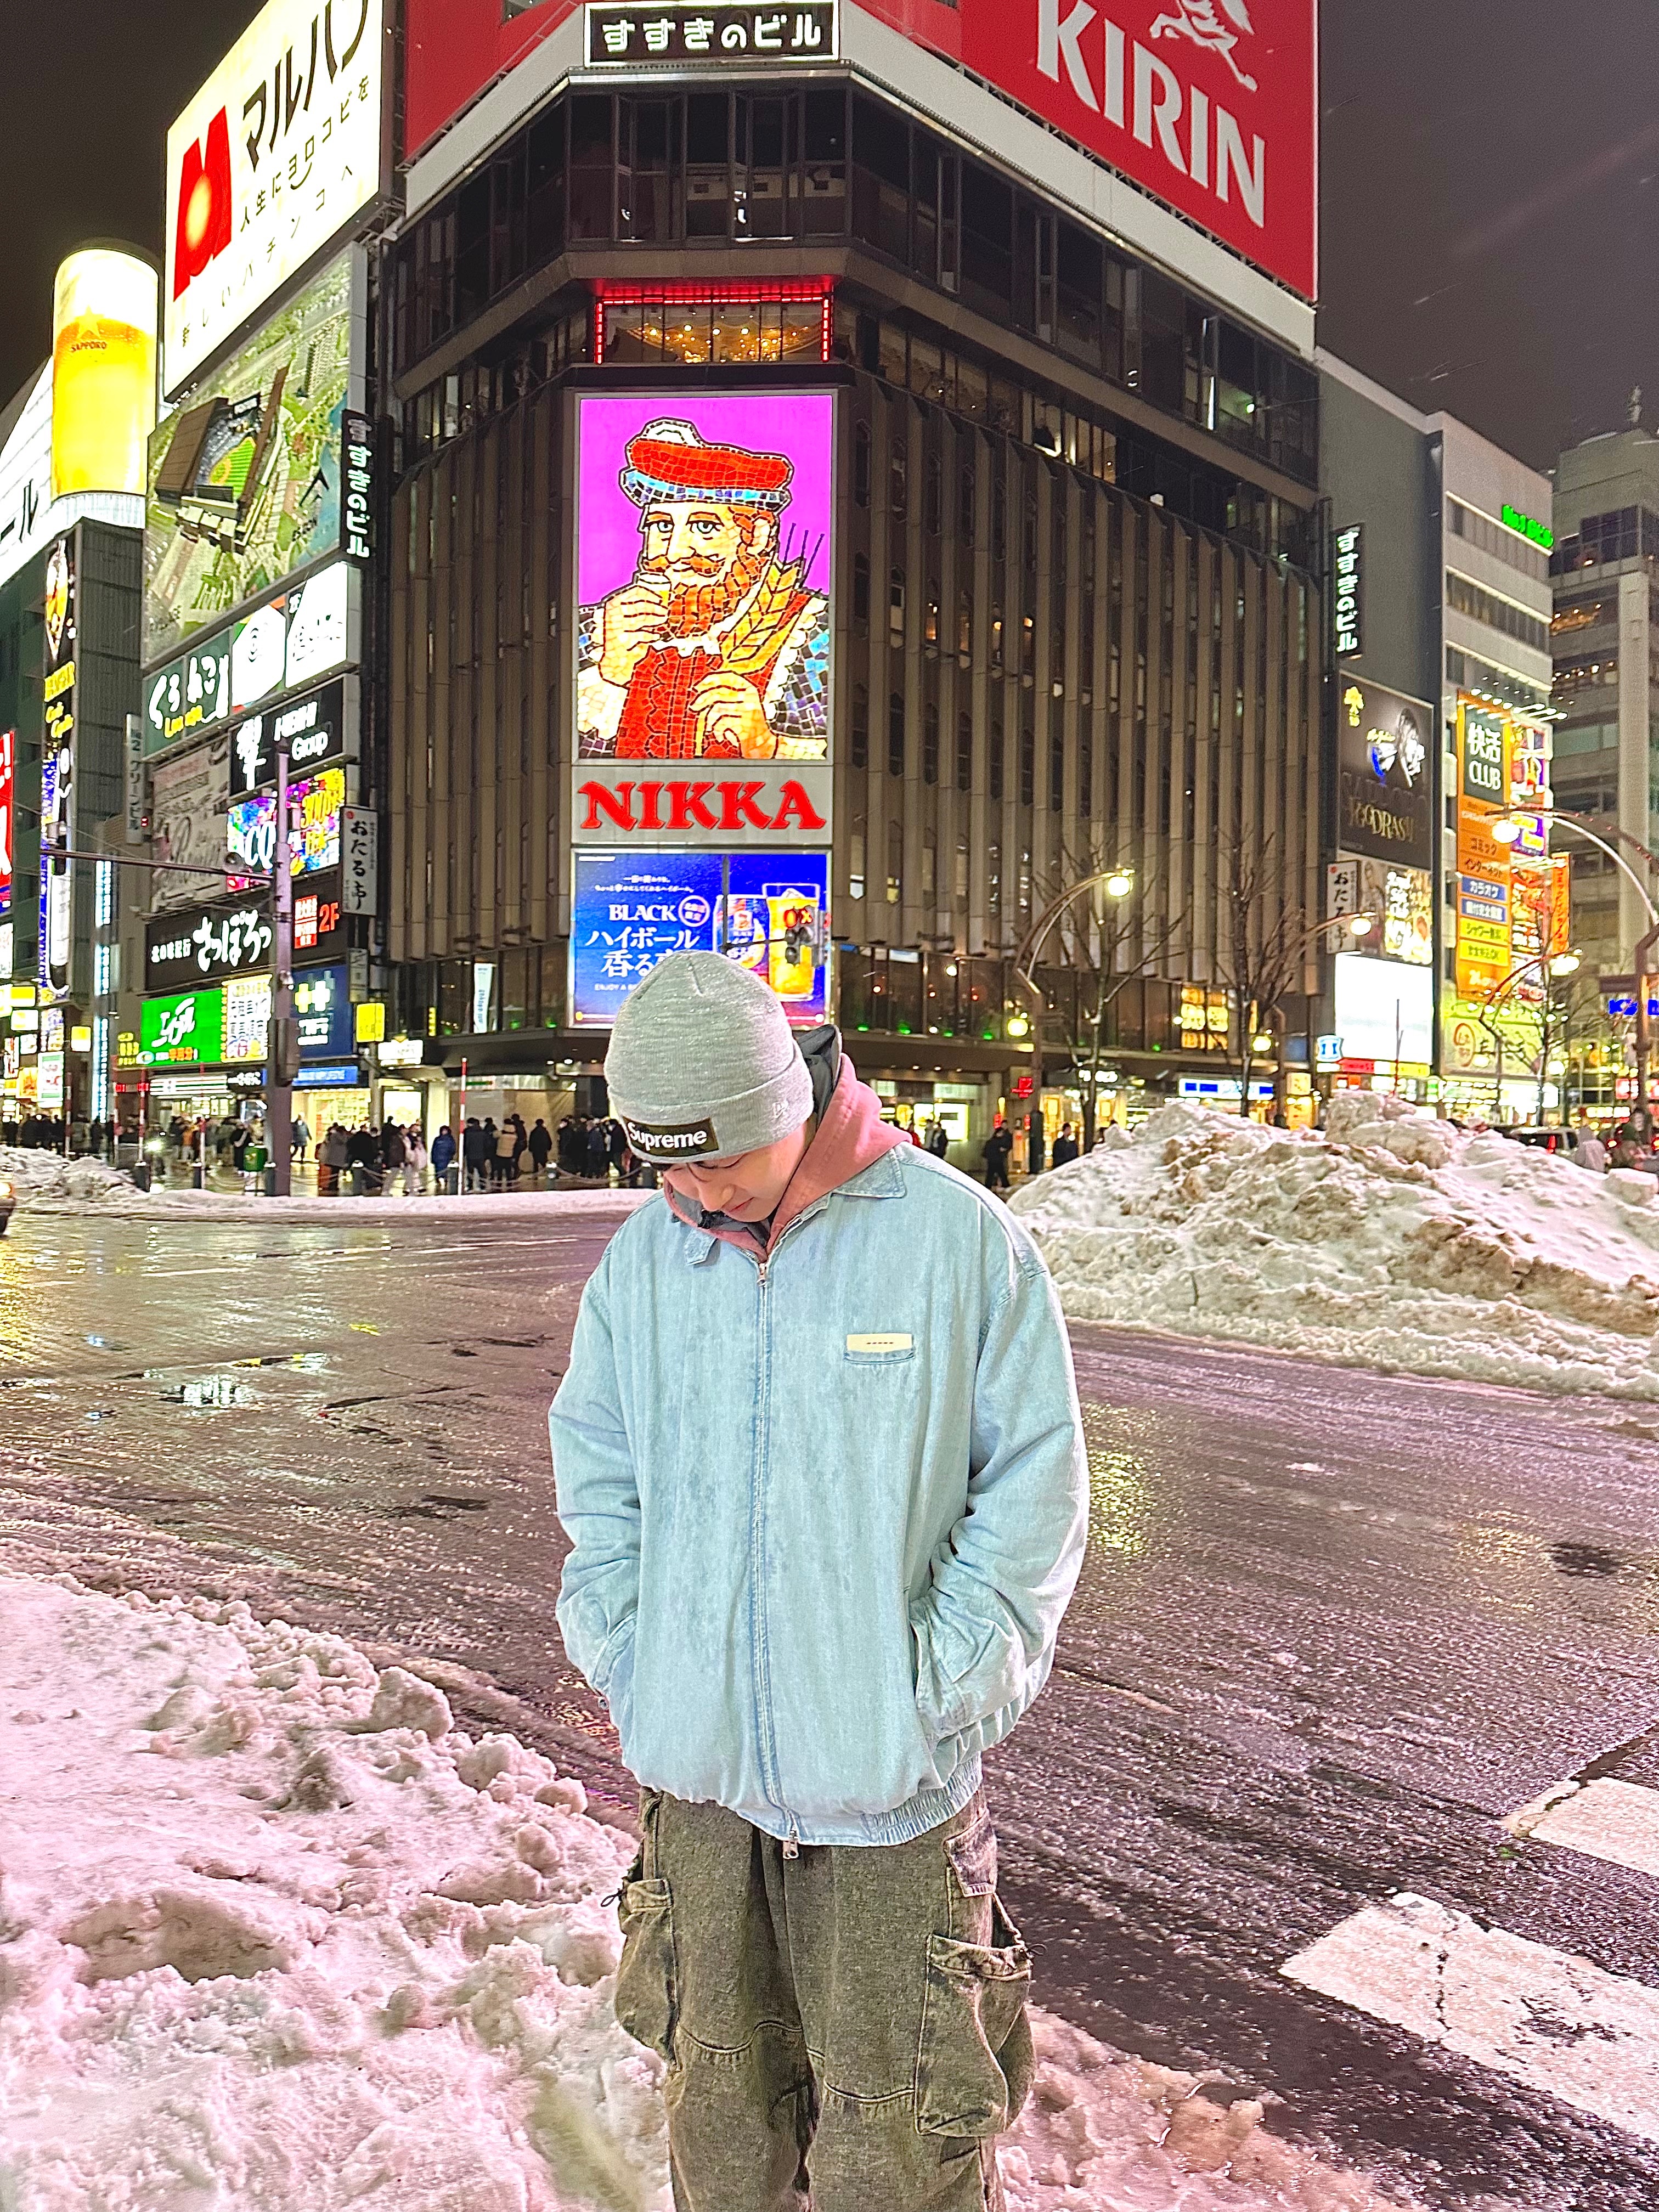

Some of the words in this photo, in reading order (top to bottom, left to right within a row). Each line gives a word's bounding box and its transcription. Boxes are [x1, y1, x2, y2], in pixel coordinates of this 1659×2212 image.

[602, 14, 821, 53] すすきのビル
[1036, 0, 1265, 228] KIRIN
[240, 75, 369, 233] 人生にヨロコビを
[346, 418, 373, 558] すすきのビル
[1336, 531, 1359, 653] すすきのビル
[1468, 722, 1502, 763] 快活
[1469, 760, 1502, 790] CLUB
[578, 780, 826, 831] NIKKA
[1470, 837, 1497, 856] コミック
[319, 902, 340, 933] 2F
[609, 904, 678, 921] BLACK
[585, 926, 701, 949] ハイボール
[628, 1122, 708, 1151] Supreme
